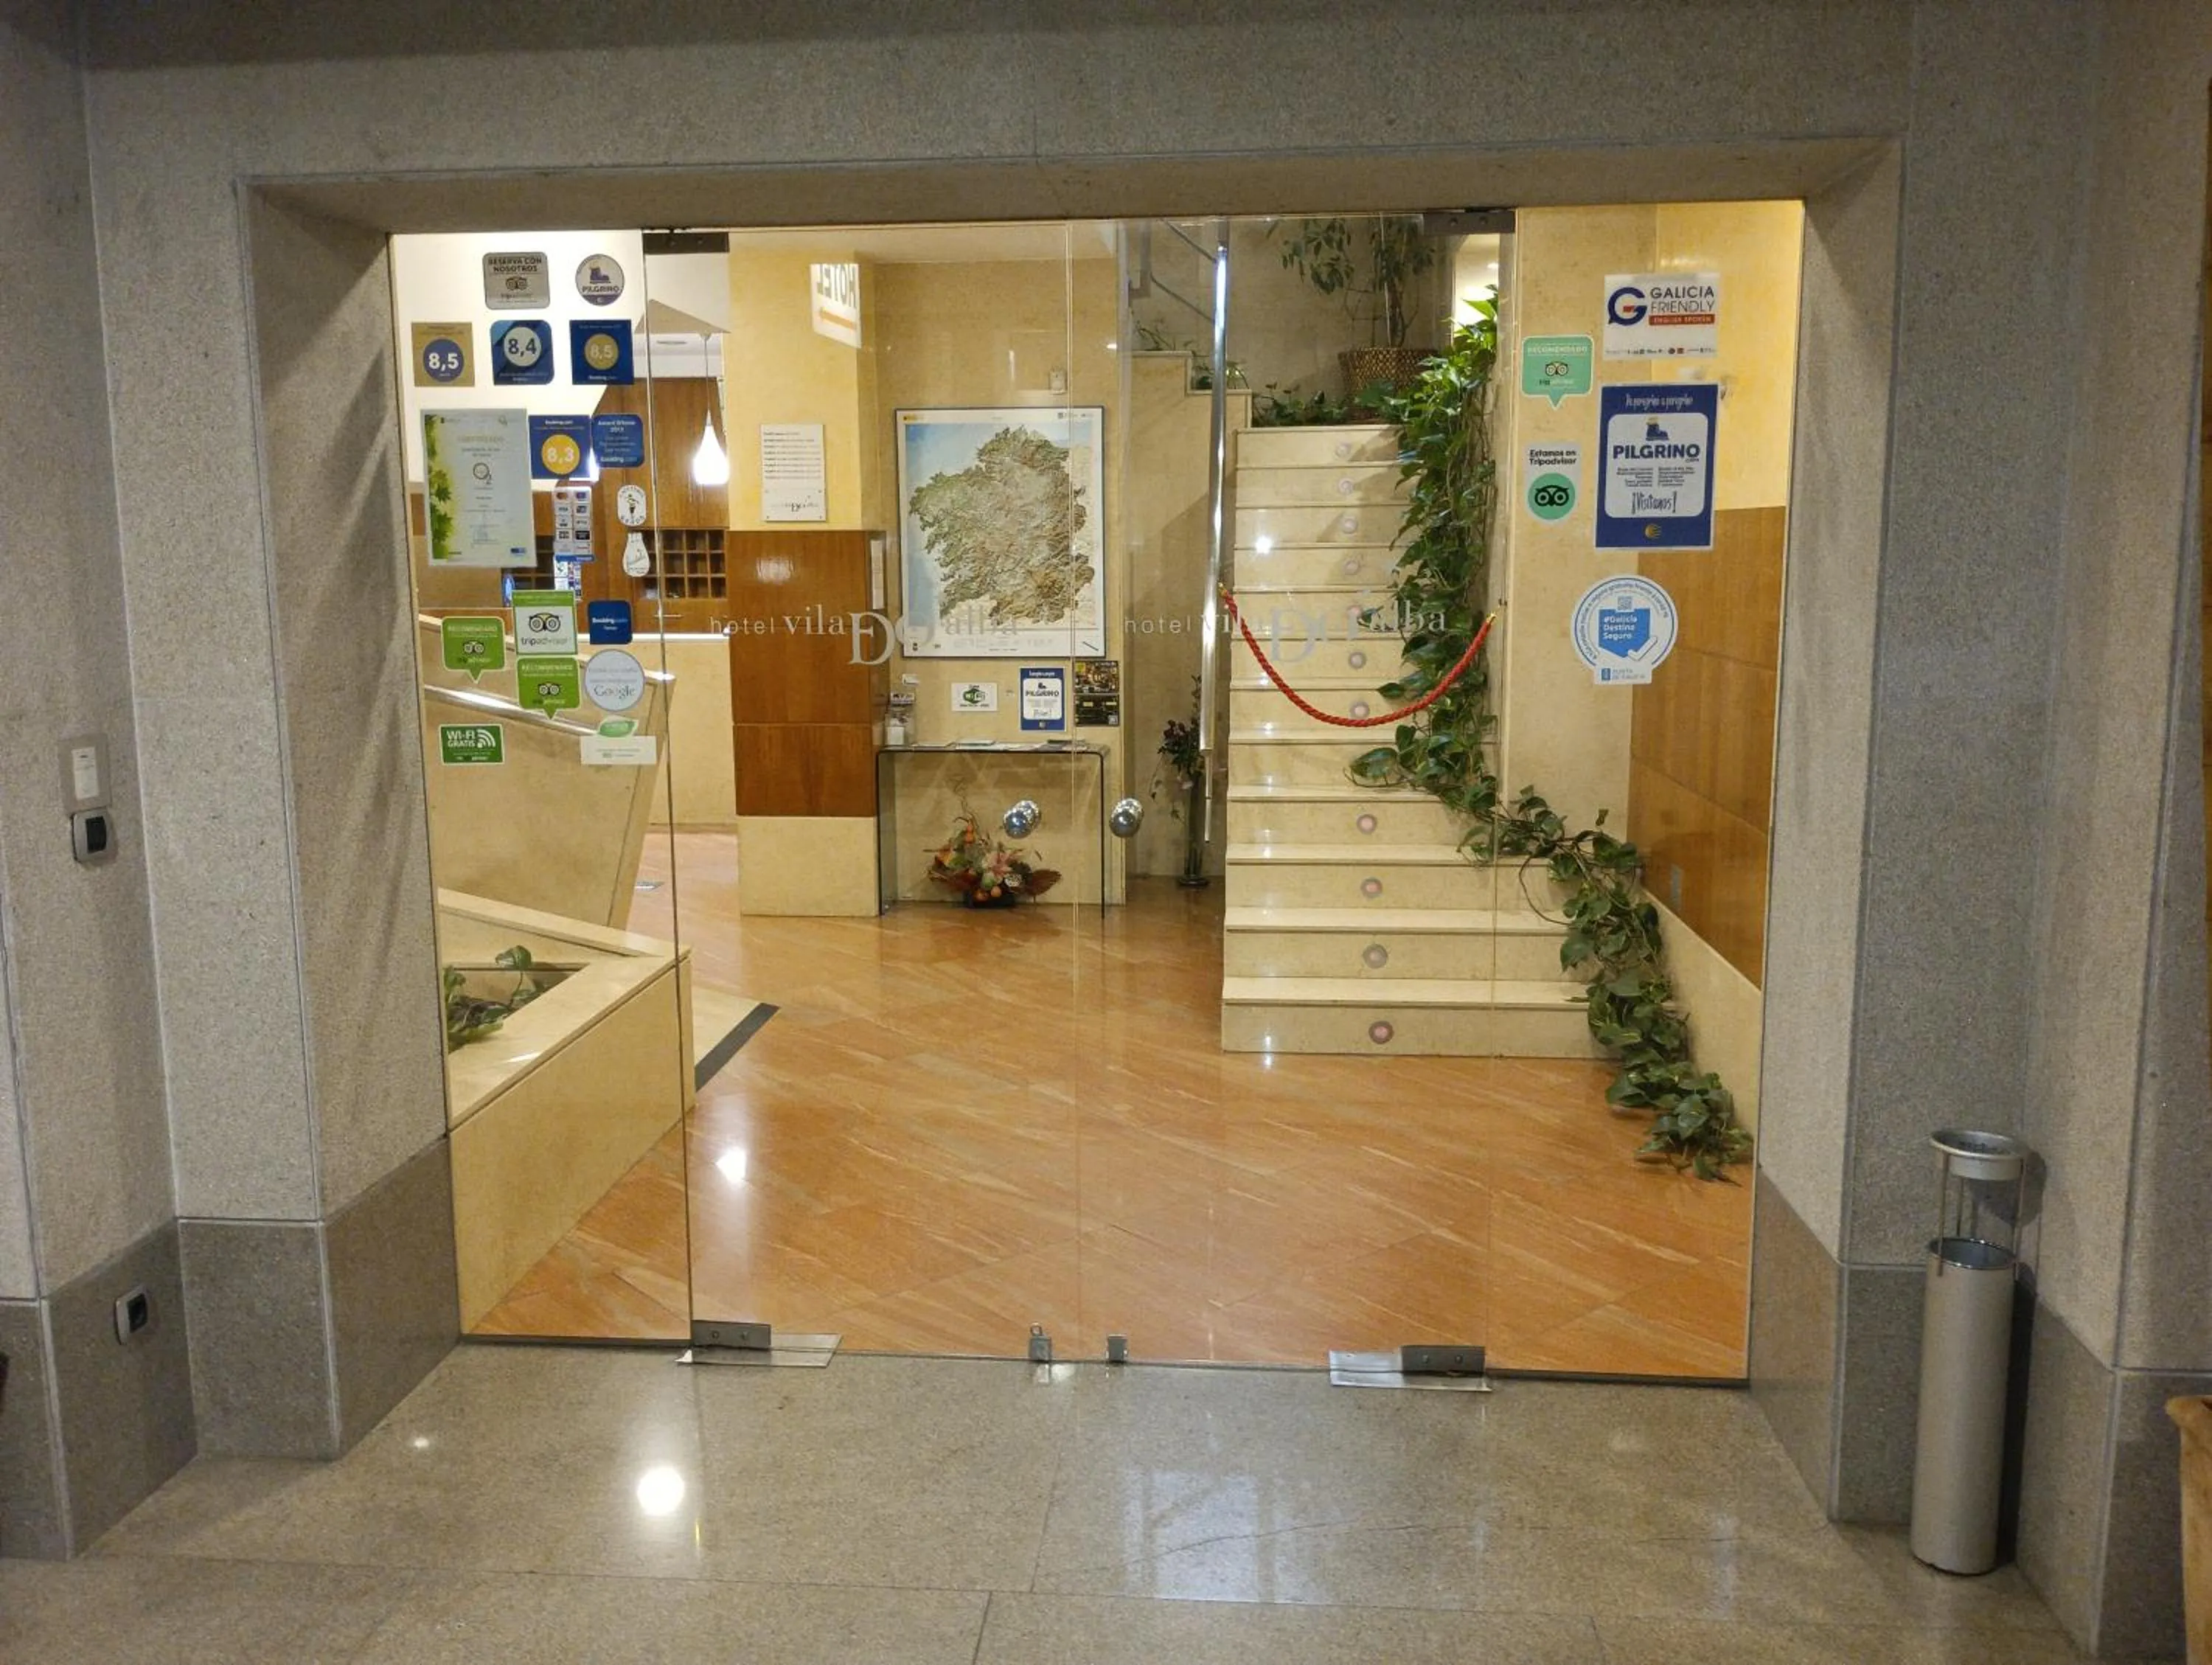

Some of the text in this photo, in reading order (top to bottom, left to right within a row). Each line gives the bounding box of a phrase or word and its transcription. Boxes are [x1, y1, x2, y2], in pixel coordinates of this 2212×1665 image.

[1650, 285, 1714, 299] GALICIA
[1651, 300, 1715, 313] FRIENDLY
[507, 337, 538, 358] 8,4
[428, 352, 459, 371] 8,5
[1613, 444, 1700, 459] PILGRINO
[709, 616, 775, 635] hotel
[1124, 613, 1192, 634] hotel
[594, 684, 636, 700] Google
[446, 729, 476, 740] WI-FI
